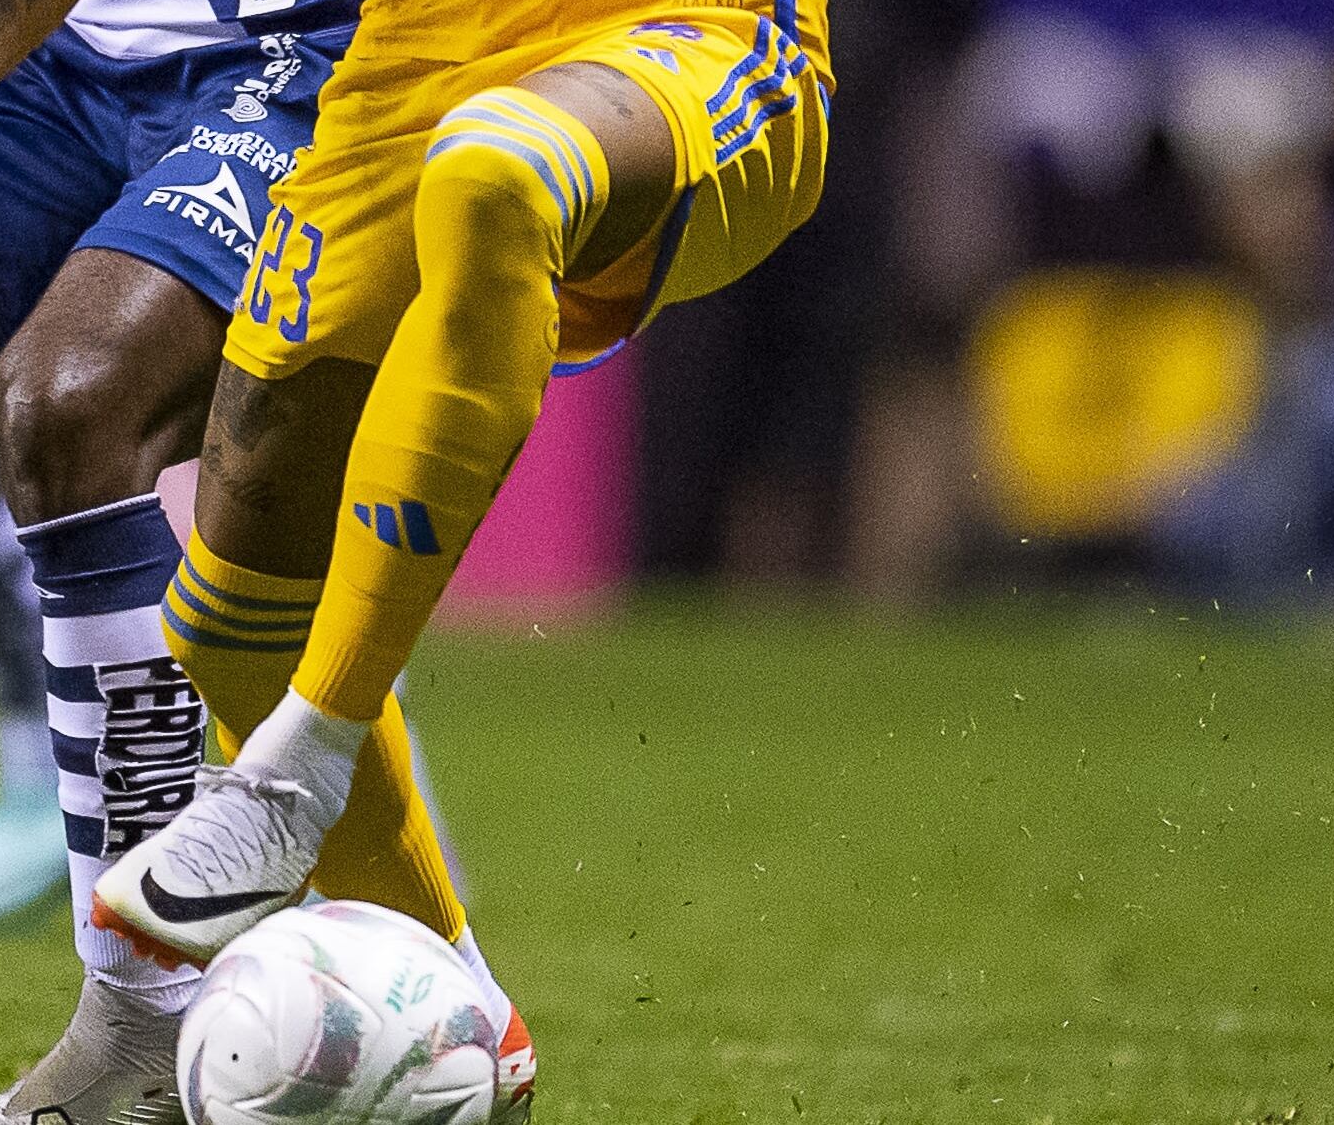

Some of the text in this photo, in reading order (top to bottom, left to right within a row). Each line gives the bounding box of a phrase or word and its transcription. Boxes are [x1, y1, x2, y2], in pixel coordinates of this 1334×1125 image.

[192, 135, 288, 180] ORIENT
[143, 190, 255, 269] PIRMA
[250, 204, 324, 343] 23
